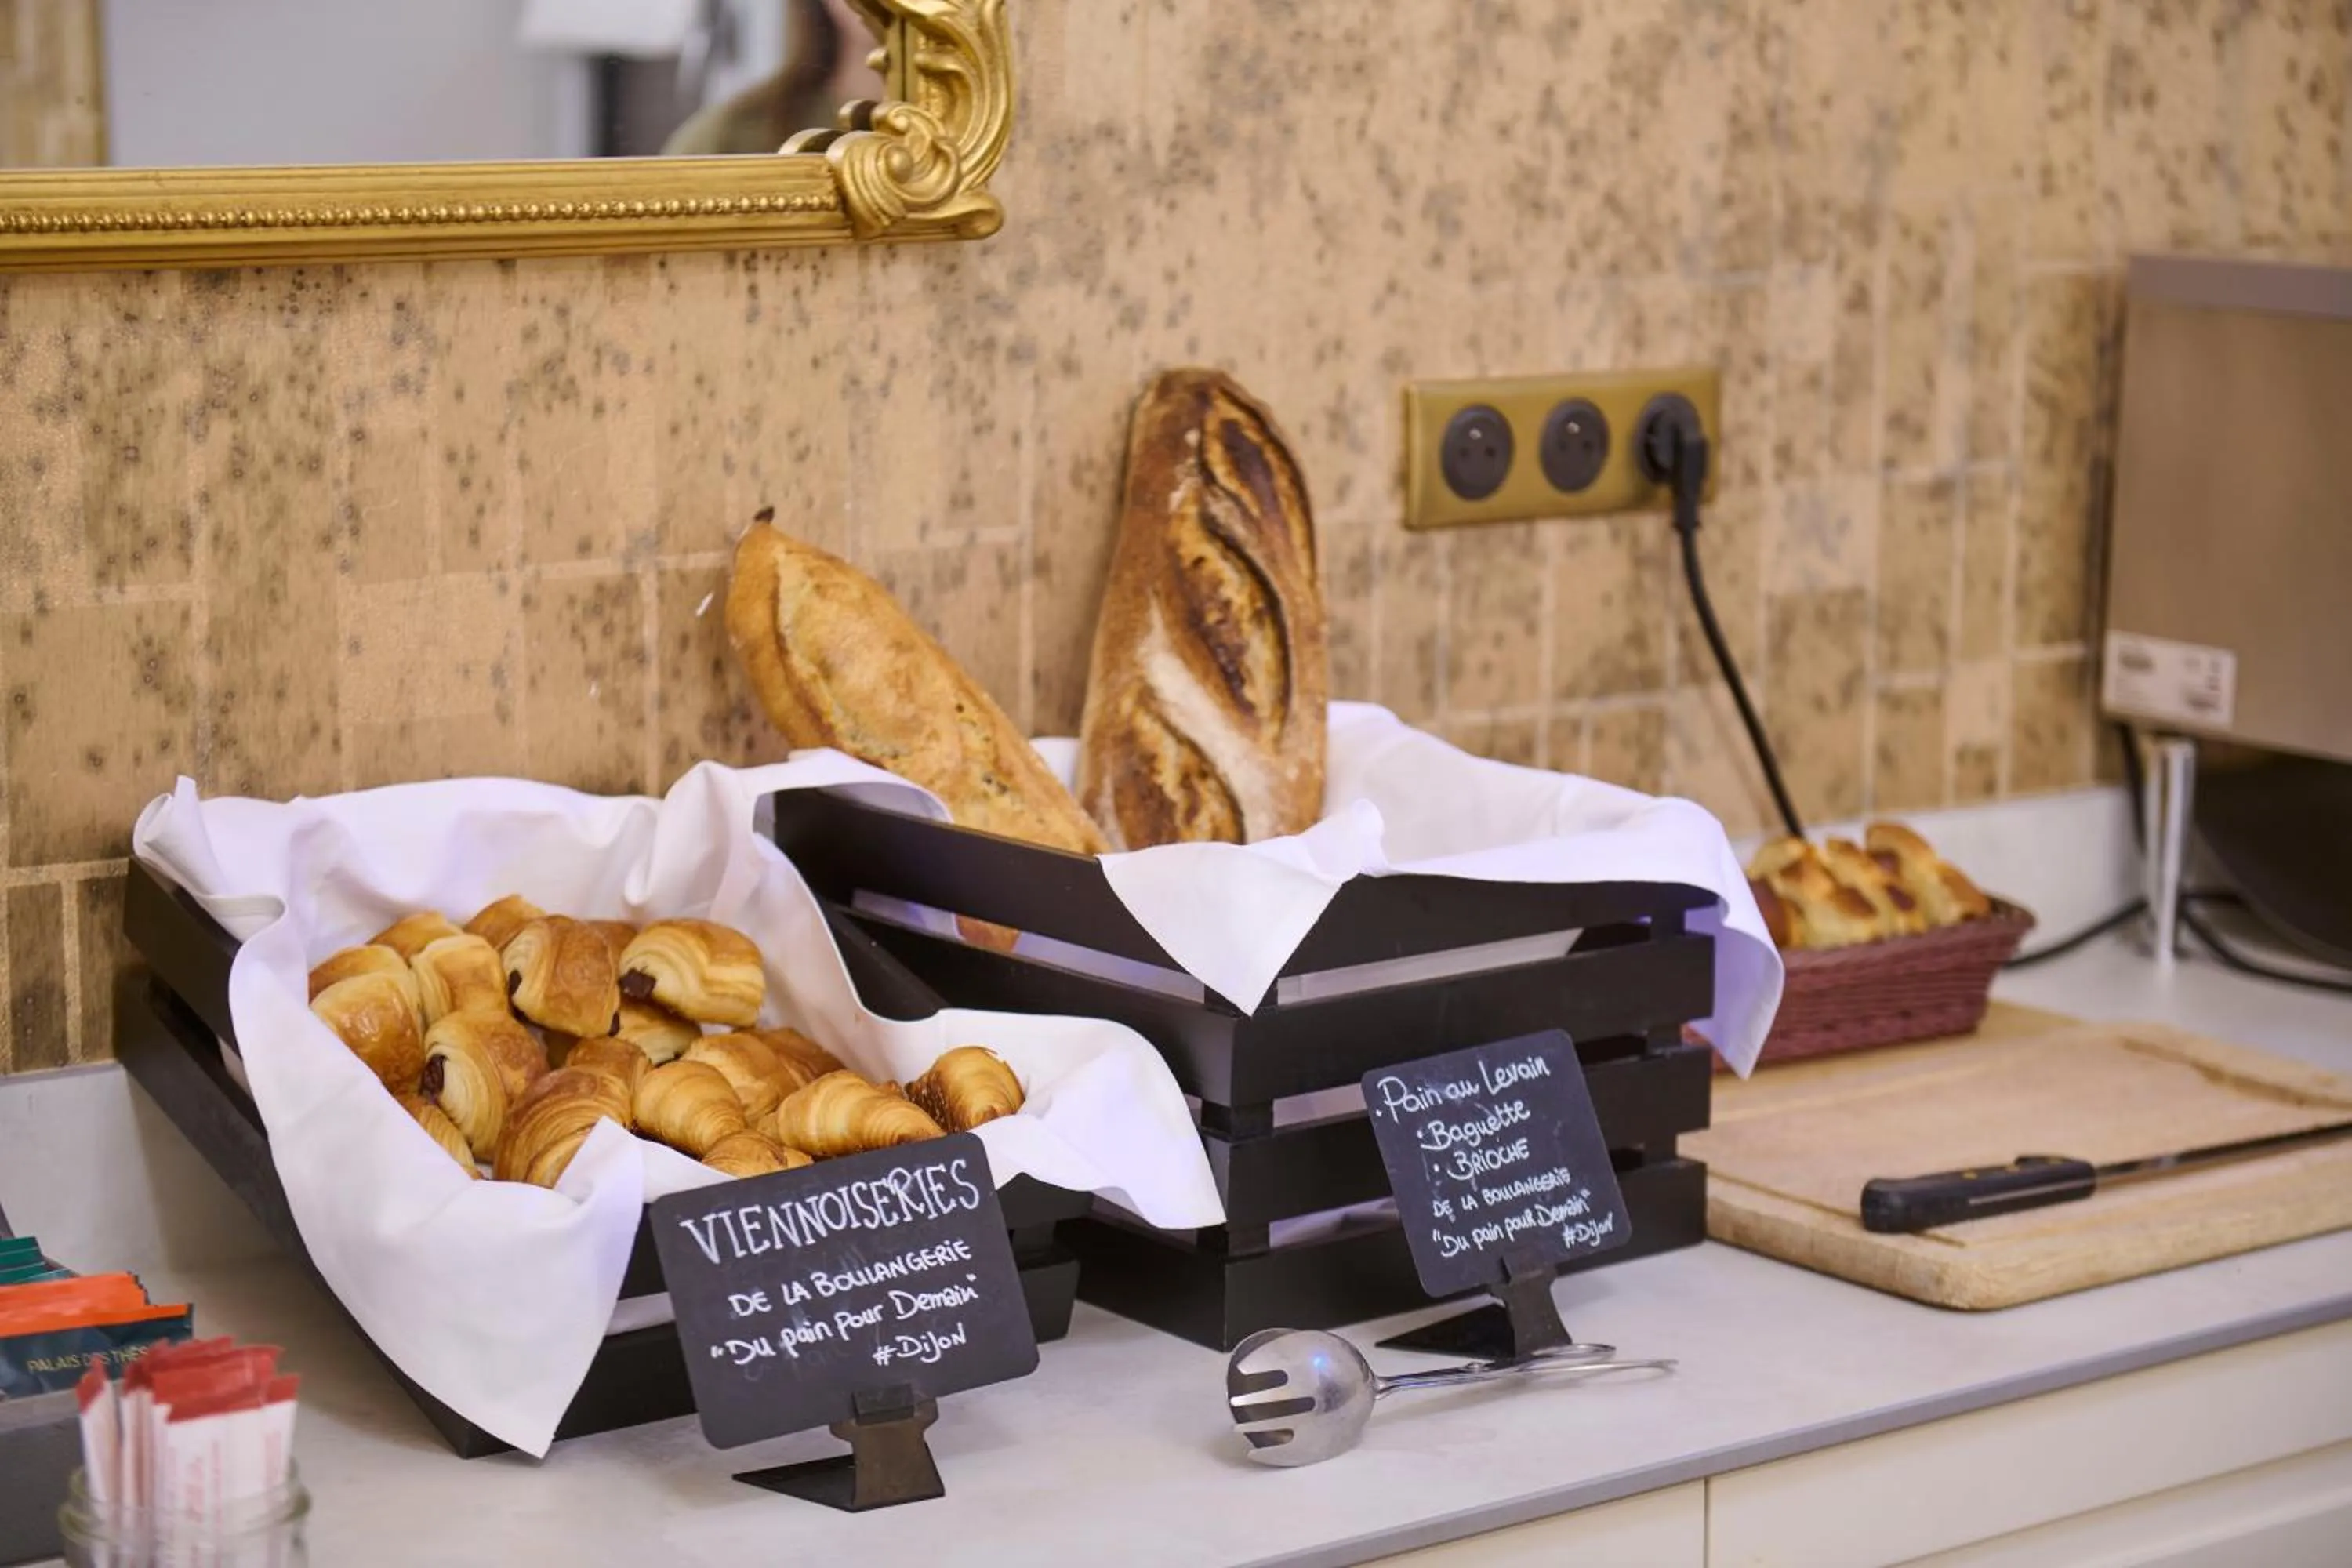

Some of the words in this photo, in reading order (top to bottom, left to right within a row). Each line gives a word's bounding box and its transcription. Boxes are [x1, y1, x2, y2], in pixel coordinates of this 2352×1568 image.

[1377, 1076, 1443, 1123] Pain
[1445, 1078, 1479, 1100] au
[1478, 1056, 1550, 1096] Levain
[1421, 1099, 1530, 1150] Baguette
[679, 1159, 980, 1264] VIENNOISERIES
[1432, 1199, 1452, 1218] DE
[1461, 1194, 1478, 1210] LA
[1472, 1220, 1504, 1250] pain
[728, 1291, 772, 1316] DE
[782, 1279, 812, 1305] LA
[780, 1321, 833, 1358] pain
